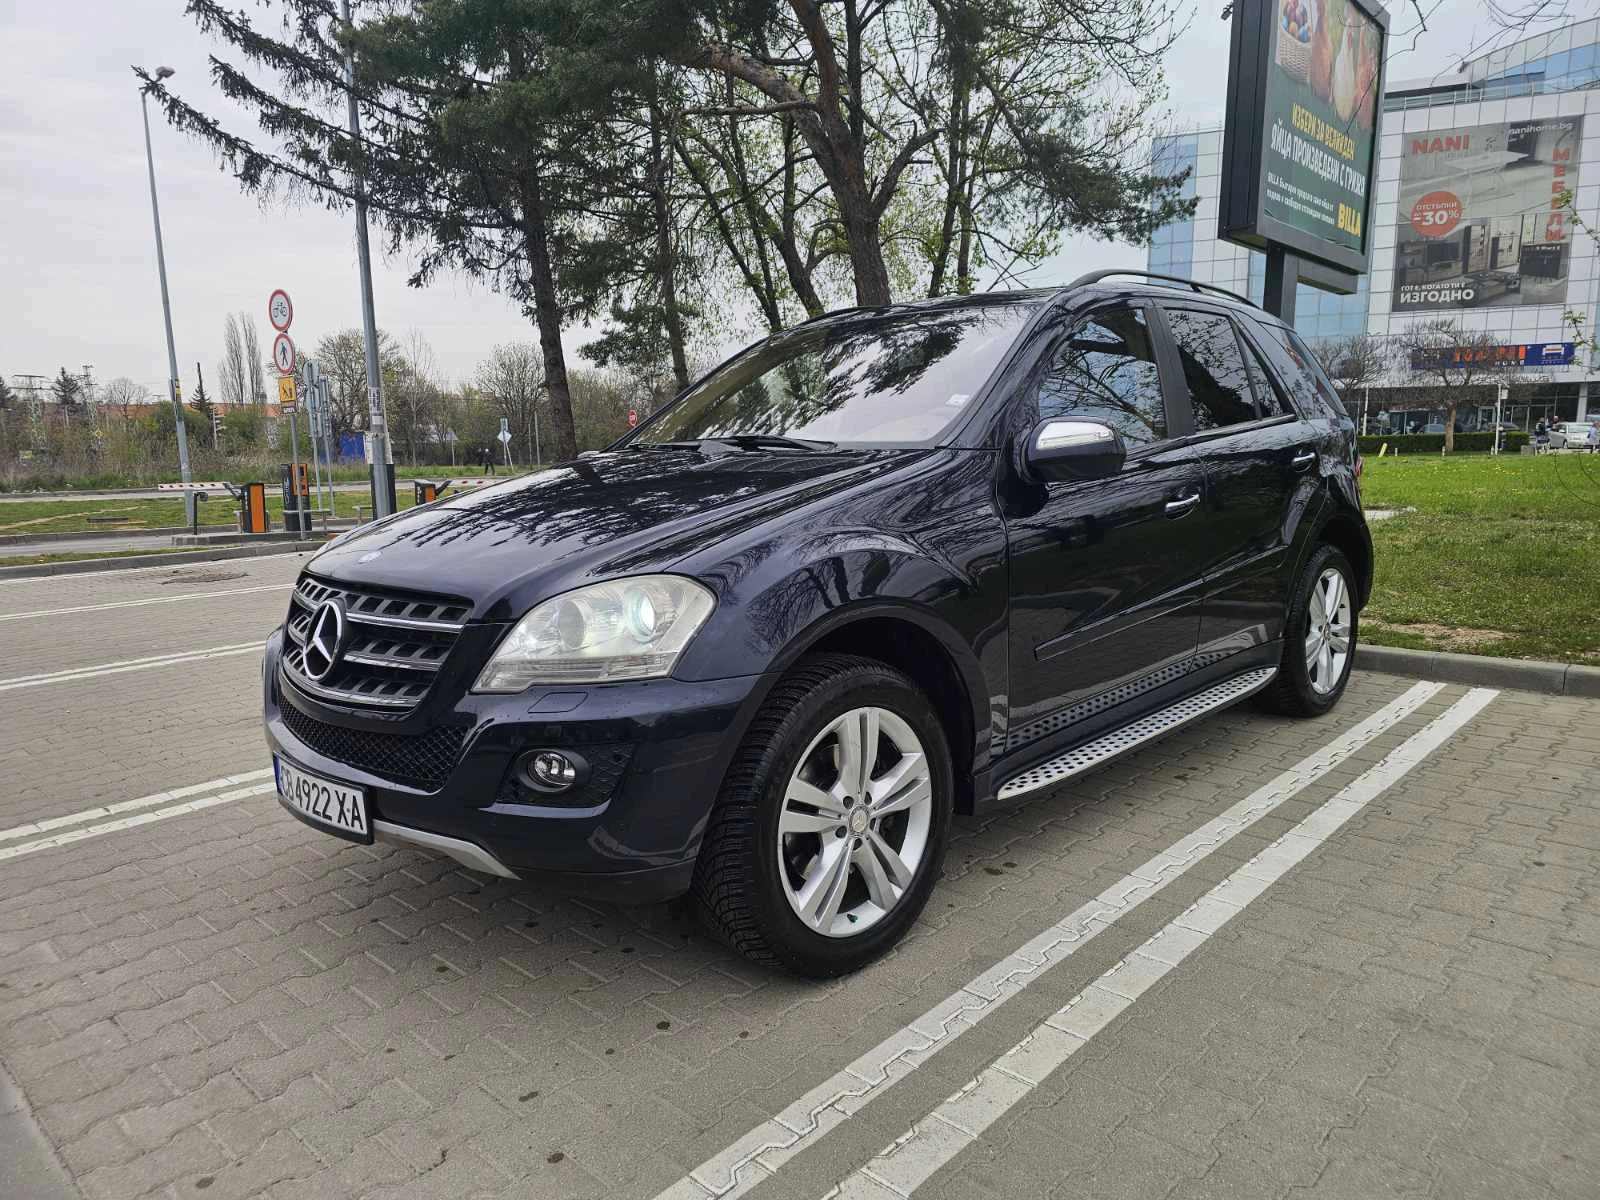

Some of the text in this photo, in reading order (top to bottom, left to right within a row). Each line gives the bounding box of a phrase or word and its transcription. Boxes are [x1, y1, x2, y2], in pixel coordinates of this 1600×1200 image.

[1292, 102, 1317, 139] ИЗБЕРИ
[1317, 119, 1325, 144] ЗА
[1508, 122, 1573, 135] nanihome.bg
[1271, 118, 1291, 159] ЯЙЦА
[1293, 135, 1339, 183] ПРОИЗВЕДЕНИ
[1340, 163, 1345, 186] С
[1411, 134, 1470, 156] NANI
[1338, 202, 1361, 237] BILLA
[1400, 289, 1474, 304] ИЗГОДНО
